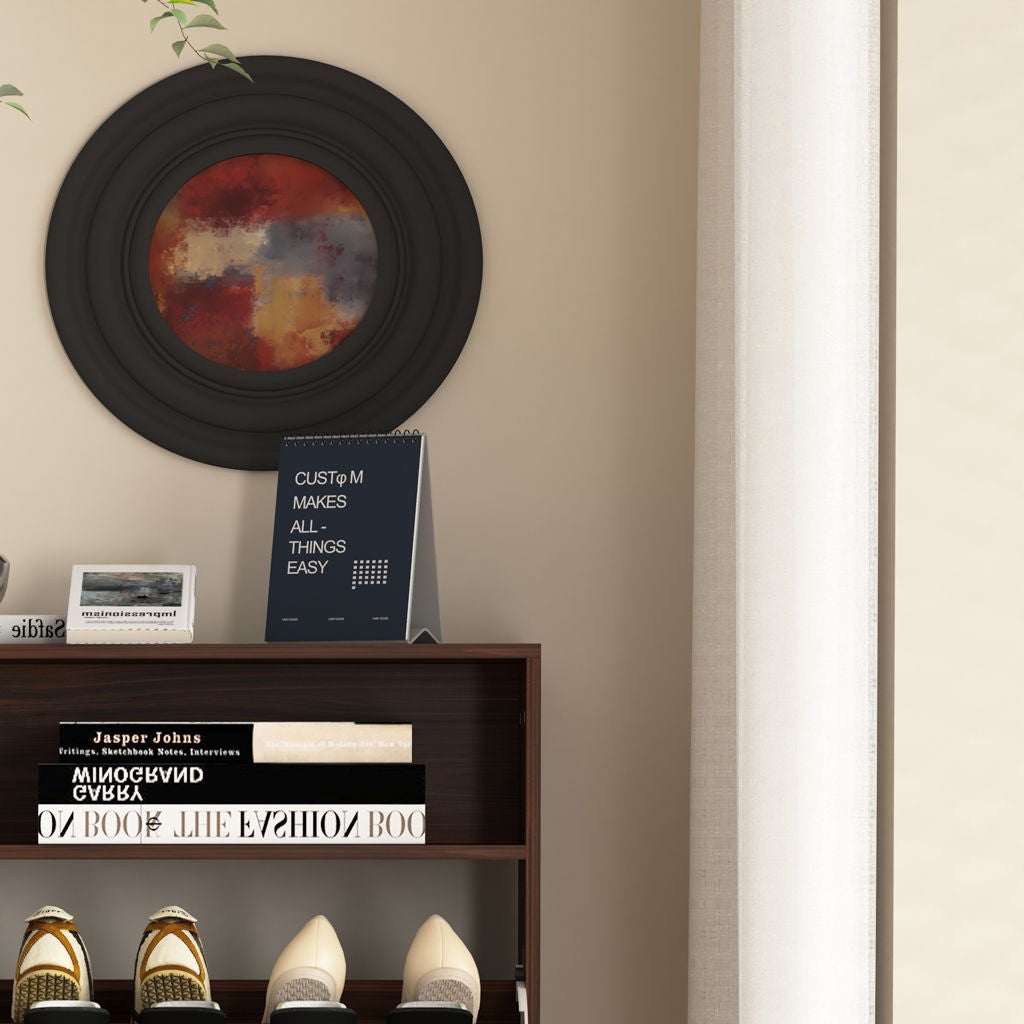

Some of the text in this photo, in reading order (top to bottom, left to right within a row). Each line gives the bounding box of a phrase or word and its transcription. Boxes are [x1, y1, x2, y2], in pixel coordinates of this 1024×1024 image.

[293, 494, 347, 509] MAKES
[289, 539, 346, 554] THINGS
[287, 560, 329, 574] EASY
[93, 731, 202, 747] Jasper Johns
[101, 747, 154, 756] Sketchbook
[190, 748, 241, 756] Interviews
